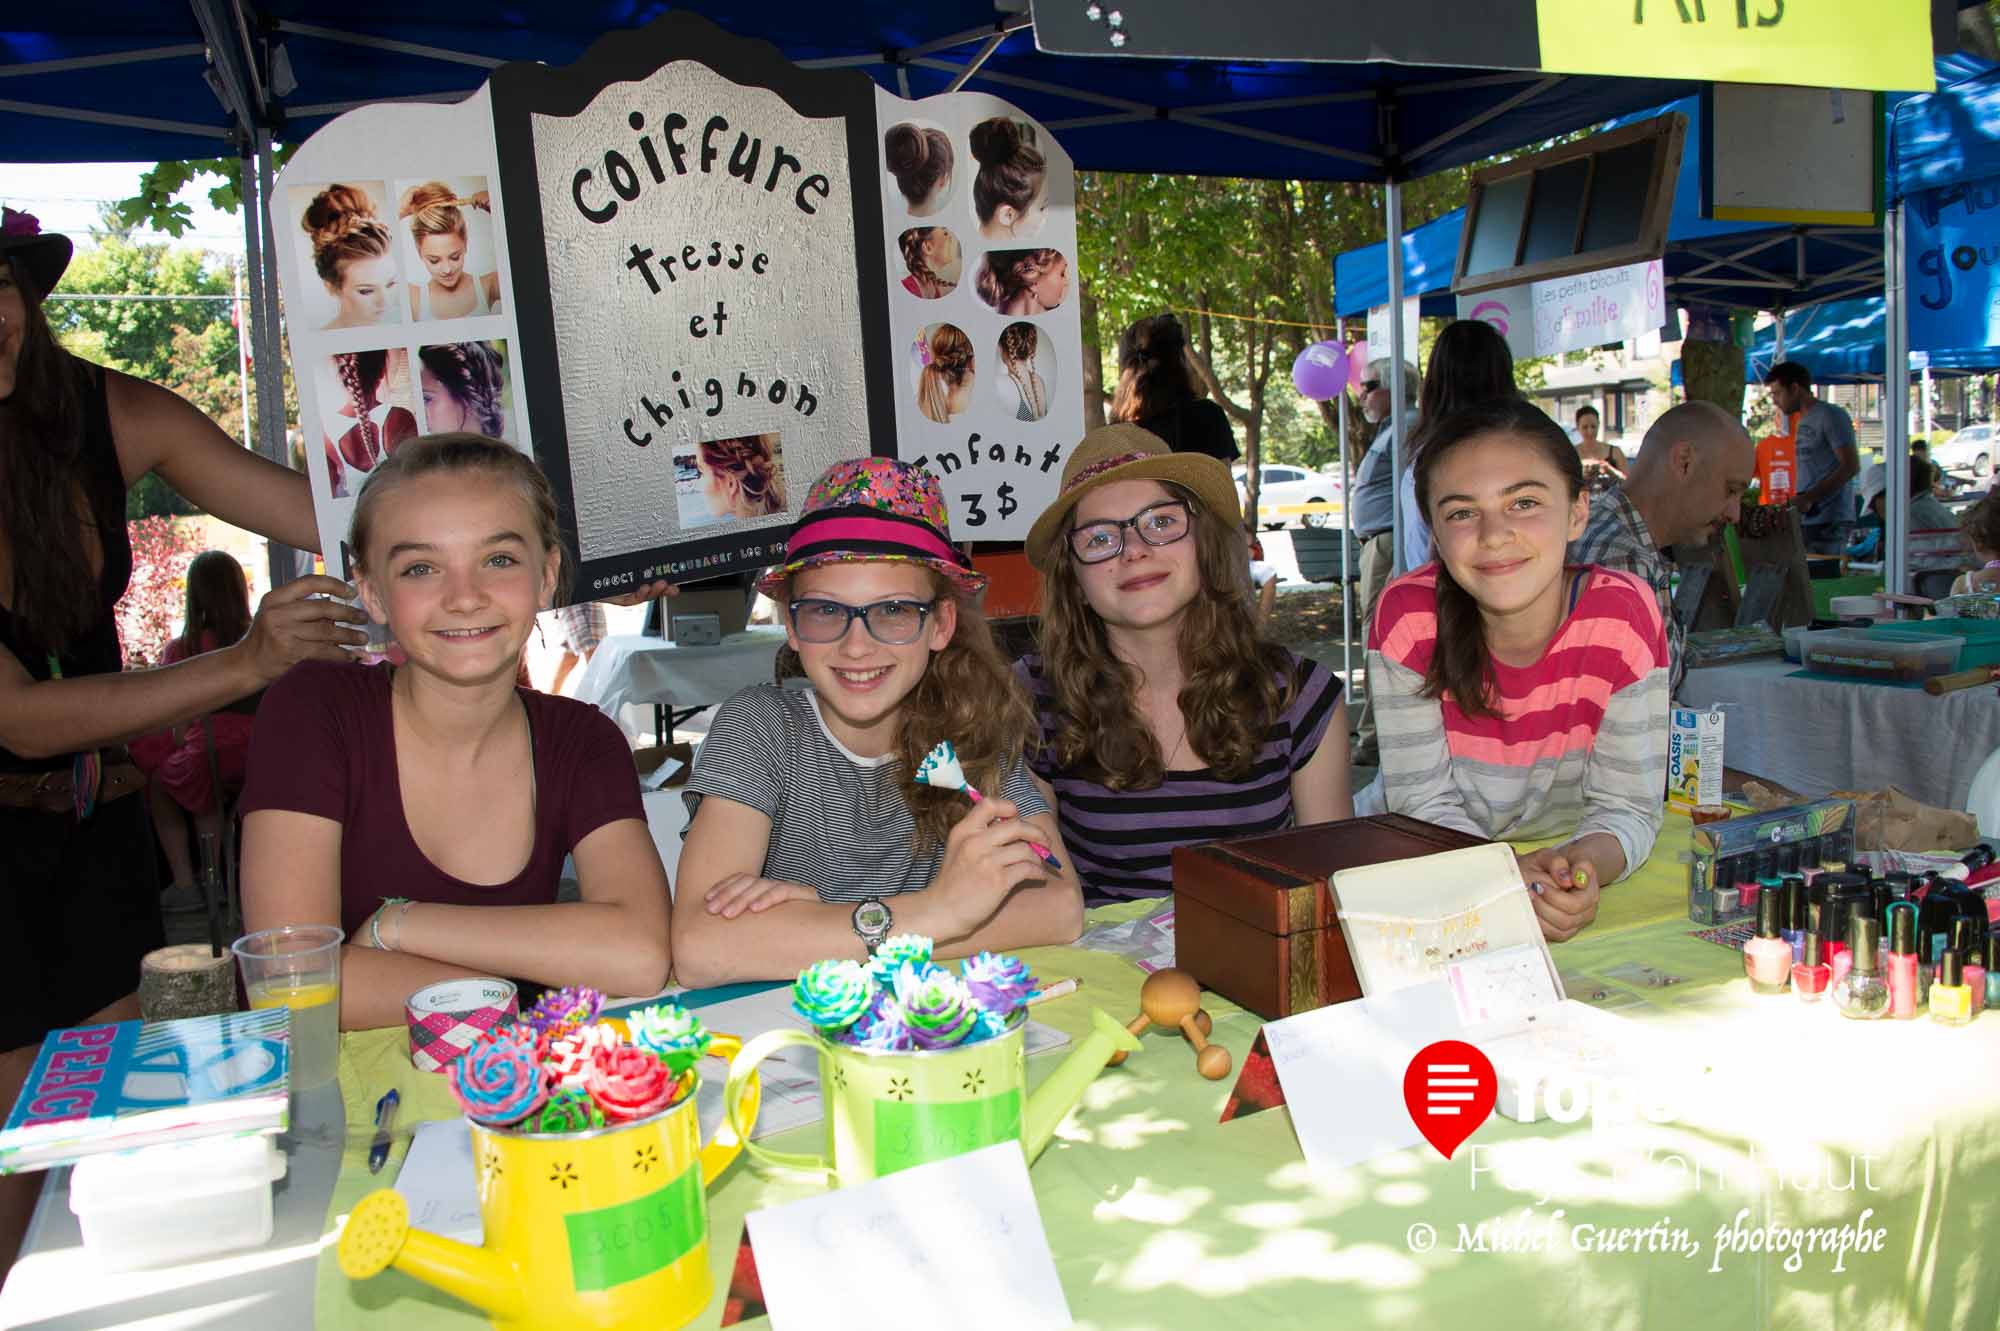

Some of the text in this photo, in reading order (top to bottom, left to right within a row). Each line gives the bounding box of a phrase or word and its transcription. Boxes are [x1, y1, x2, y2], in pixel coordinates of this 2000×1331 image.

[689, 301, 728, 338] et
[914, 432, 1061, 474] nfant
[1671, 732, 1682, 776] OASIS
